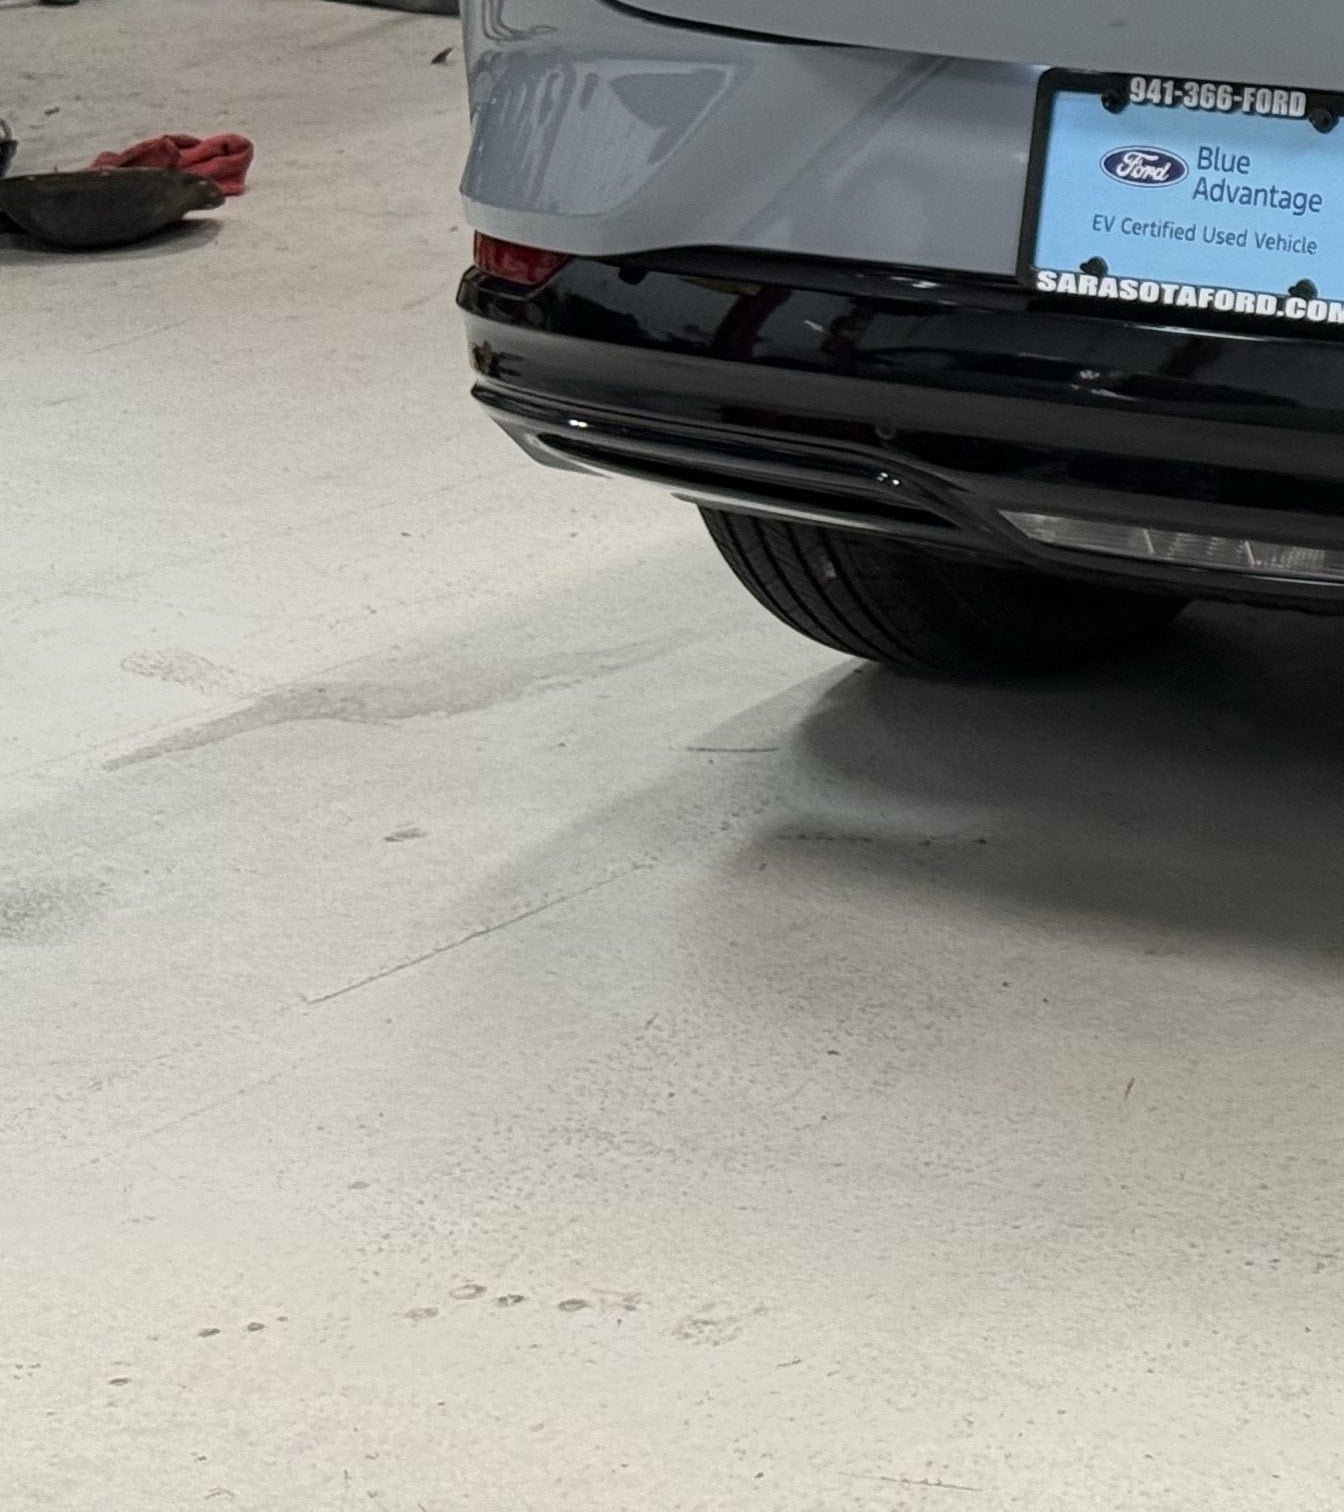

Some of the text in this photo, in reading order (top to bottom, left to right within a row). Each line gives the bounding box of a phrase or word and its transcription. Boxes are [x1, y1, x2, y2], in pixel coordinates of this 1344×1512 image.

[1130, 76, 1307, 118] 941-366-FORD
[1116, 151, 1173, 182] Ford
[1197, 146, 1251, 175] Blue
[1192, 176, 1323, 216] Advantage
[1092, 214, 1318, 255] EV Certified Used Vehicle
